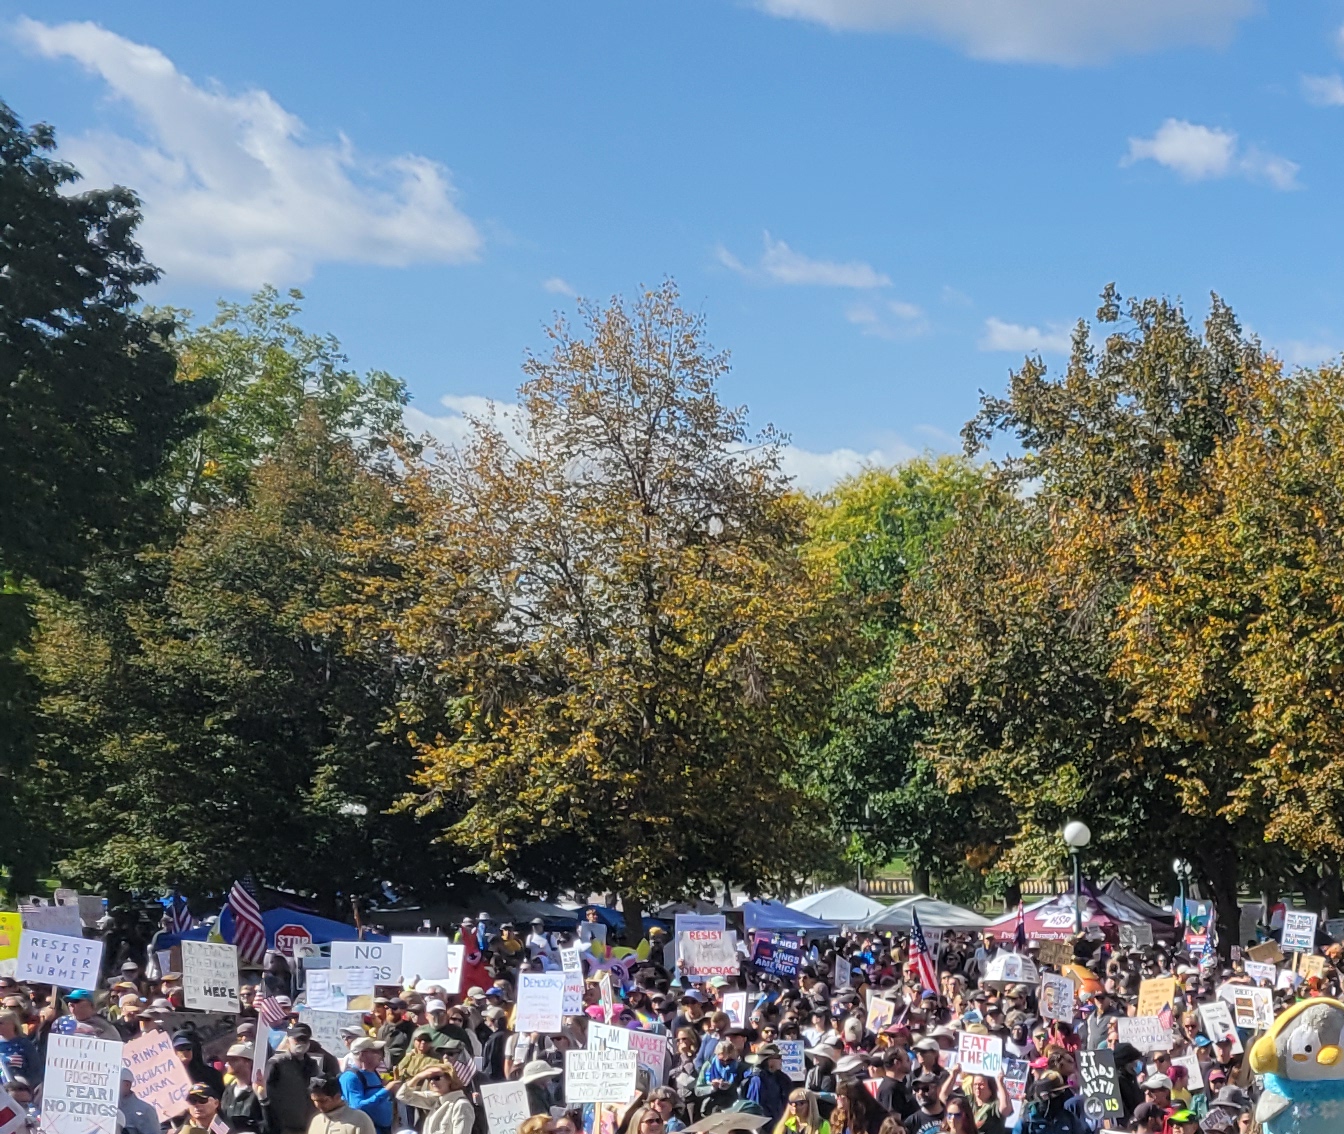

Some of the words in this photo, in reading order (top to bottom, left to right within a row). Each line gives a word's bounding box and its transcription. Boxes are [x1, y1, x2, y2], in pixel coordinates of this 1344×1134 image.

[277, 935, 309, 948] STOP
[689, 931, 722, 940] RESIST
[1001, 932, 1029, 940] Progs
[1030, 931, 1058, 940] Through
[31, 937, 93, 954] RESIST
[354, 945, 382, 959] NO
[31, 953, 91, 968] NEVER
[26, 963, 90, 981] SUBMIT
[203, 986, 237, 999] HERE
[608, 1029, 620, 1044] AM
[962, 1035, 993, 1051] EAT
[121, 1045, 159, 1068] DRINK
[960, 1050, 982, 1065] THE
[982, 1052, 1000, 1071] RICH
[1080, 1051, 1094, 1066] IT
[65, 1070, 109, 1086] FIGHT
[131, 1058, 176, 1087] ORCHATA
[1081, 1065, 1115, 1083] ENDS
[139, 1078, 175, 1099] WARM
[169, 1083, 189, 1103] ICE
[1084, 1081, 1114, 1098] WITH
[44, 1098, 67, 1112] NO
[68, 1099, 118, 1117] KINGS
[1105, 1098, 1119, 1111] US
